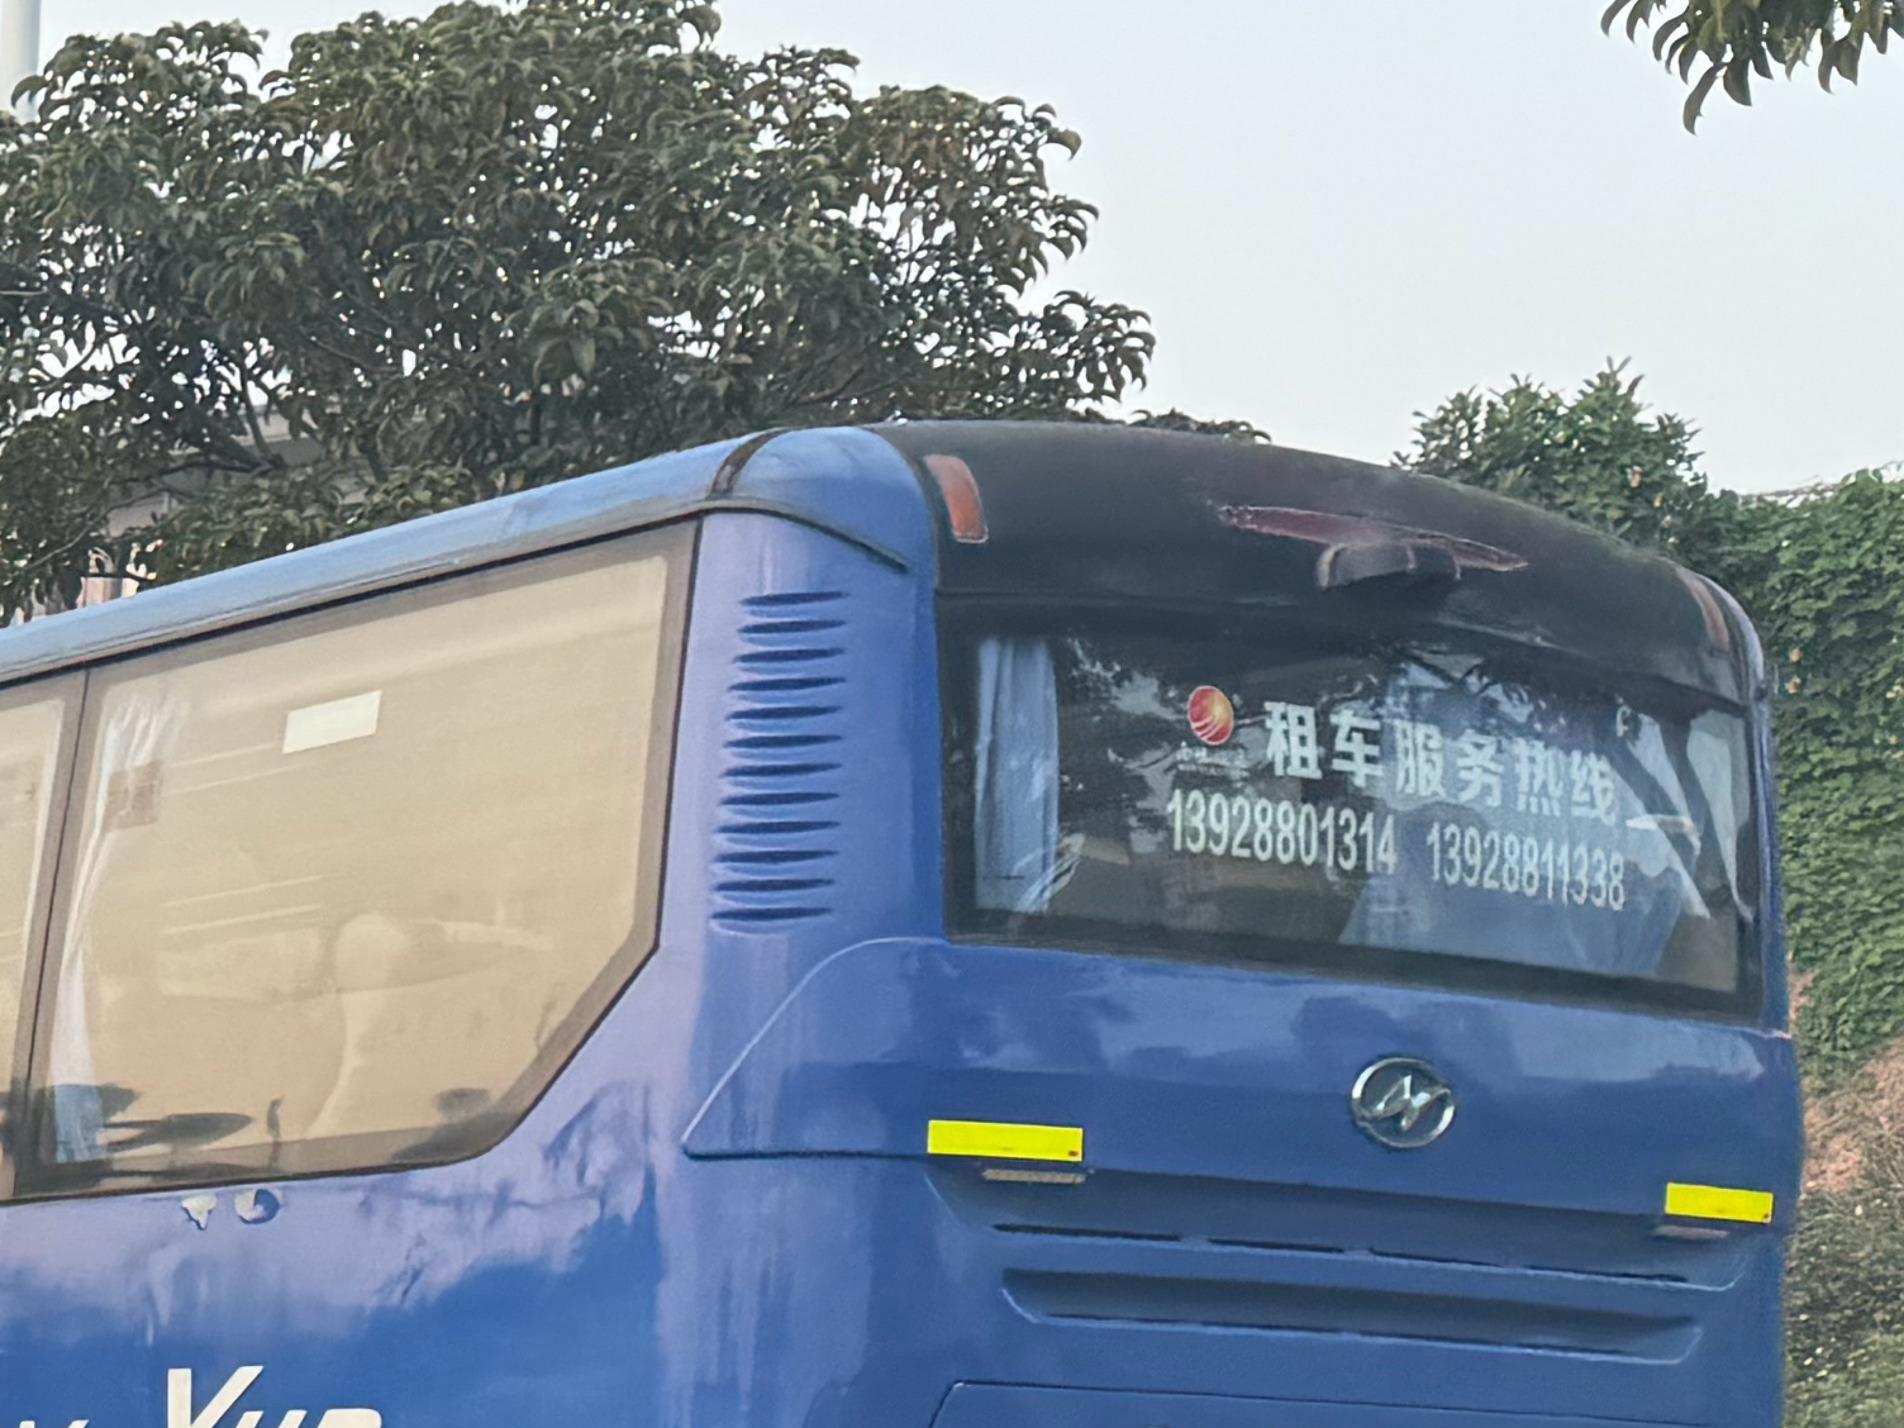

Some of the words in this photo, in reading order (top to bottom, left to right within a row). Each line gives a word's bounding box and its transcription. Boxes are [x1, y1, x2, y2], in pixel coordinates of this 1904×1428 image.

[1262, 700, 1618, 828] 租车服务热线
[1165, 789, 1399, 875] 13928801314
[1425, 820, 1627, 912] 13928811338
